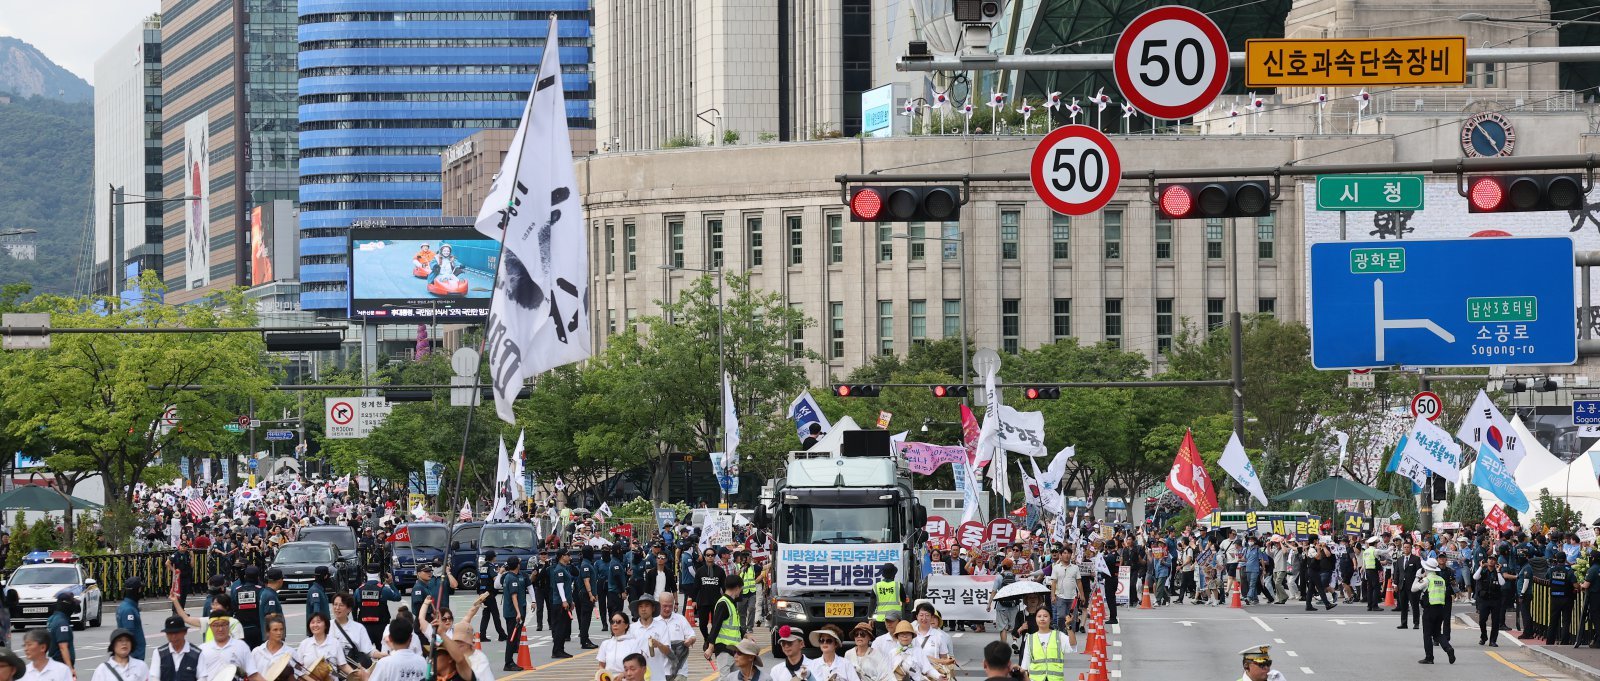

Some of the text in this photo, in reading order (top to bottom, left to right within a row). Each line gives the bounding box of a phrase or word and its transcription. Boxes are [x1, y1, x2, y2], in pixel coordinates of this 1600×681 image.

[1140, 38, 1204, 86] 50
[1263, 47, 1449, 78] 신호과속단속장비
[1052, 148, 1103, 192] 50
[1354, 252, 1401, 270] 광화문
[1472, 301, 1532, 318] 남산3호터널
[1476, 325, 1529, 342] 소공로
[1472, 344, 1534, 356] Sogong-ro
[1418, 399, 1436, 414] 50
[1576, 404, 1600, 414] 소공
[991, 523, 1014, 544] 단
[782, 550, 900, 562] 내란청산 국민주권실현
[926, 588, 956, 605] 주권
[832, 608, 852, 616] 2973
